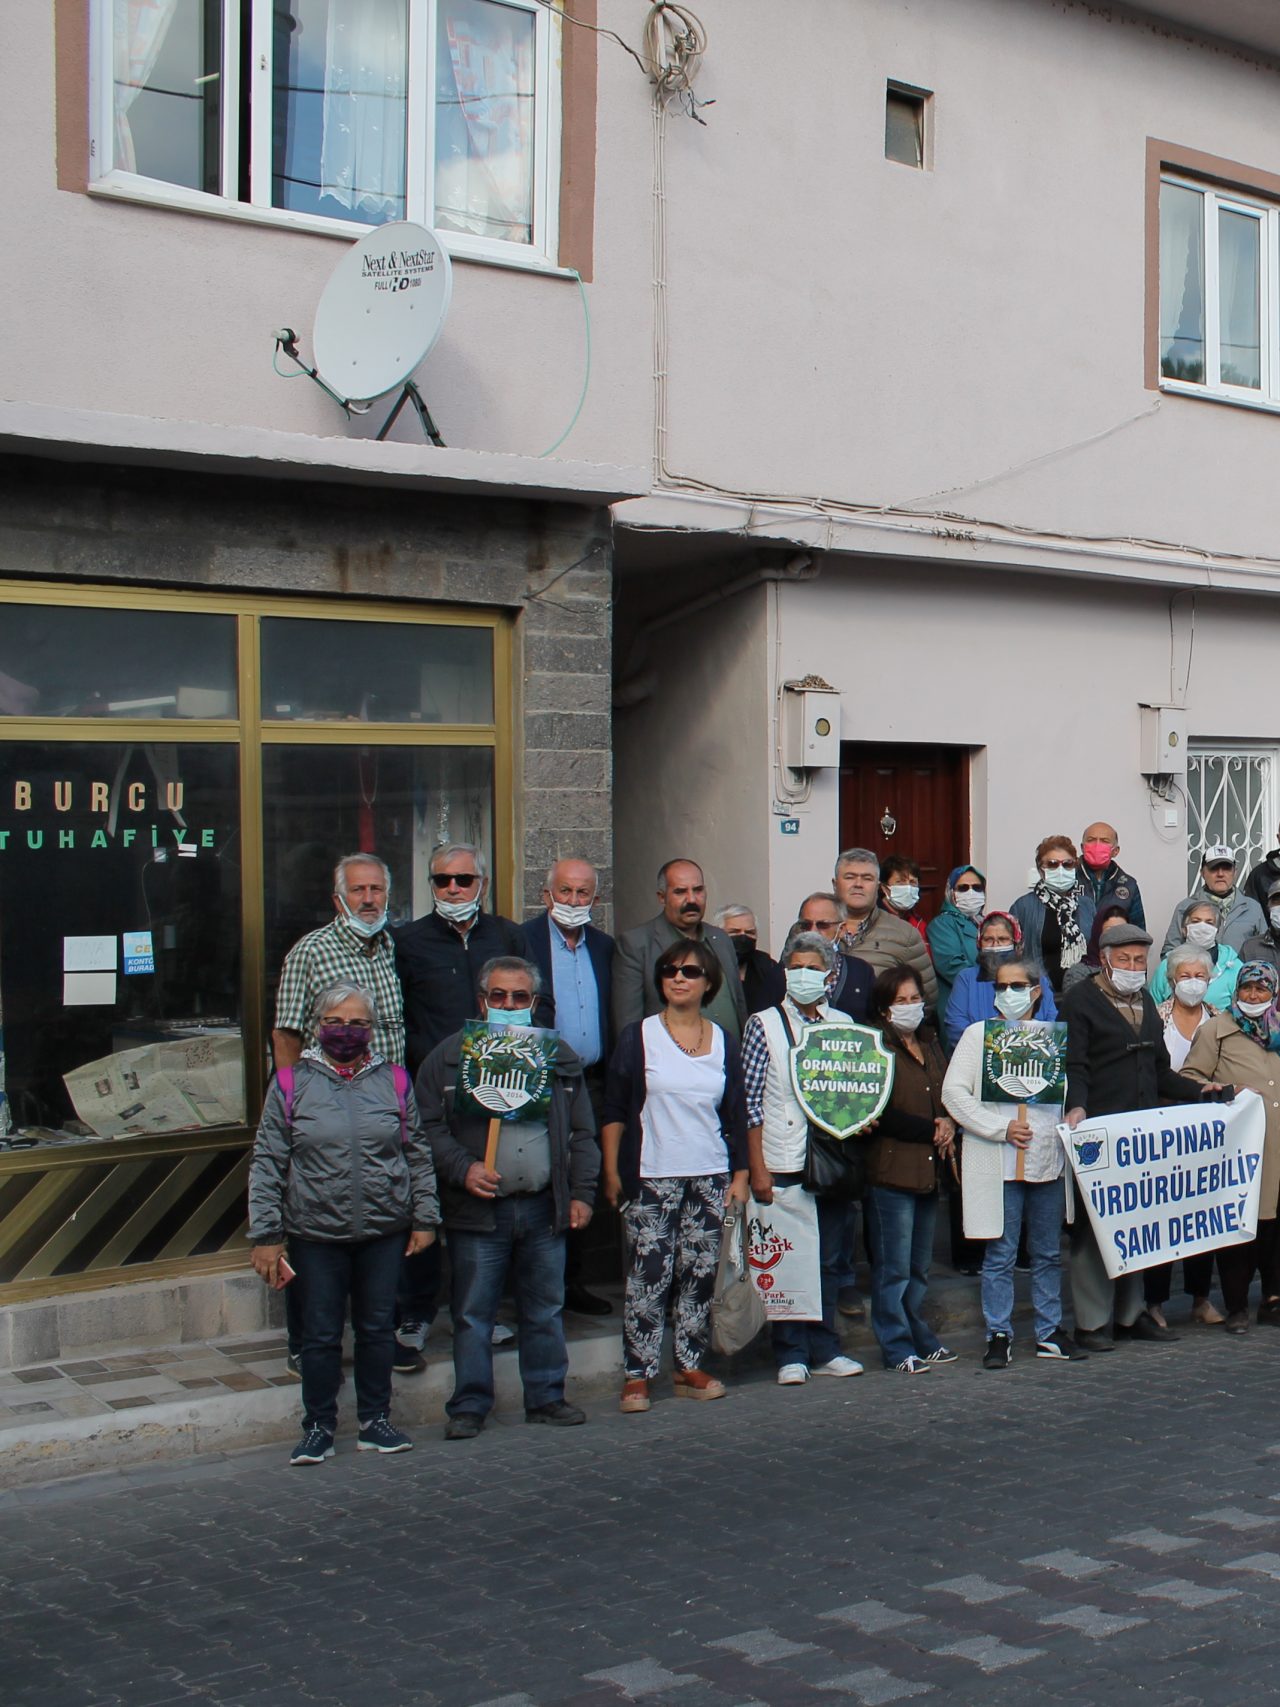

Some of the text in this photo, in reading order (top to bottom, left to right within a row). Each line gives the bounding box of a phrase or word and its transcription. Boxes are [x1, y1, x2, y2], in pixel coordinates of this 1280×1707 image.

[362, 249, 434, 271] Next & NextStar
[404, 265, 434, 275] SYSTEMS
[15, 781, 183, 811] BURCU
[785, 822, 796, 832] 94
[0, 825, 214, 849] TUHAFİYE
[821, 1040, 862, 1052] KUZEY
[803, 1059, 881, 1073] ORMANLARI
[803, 1080, 879, 1094] SAVUNMASI
[1116, 1119, 1226, 1168] GÜLPINAR
[1091, 1149, 1260, 1218] ÜRDÜRÜLEBİLİR
[747, 1238, 794, 1256] etPark
